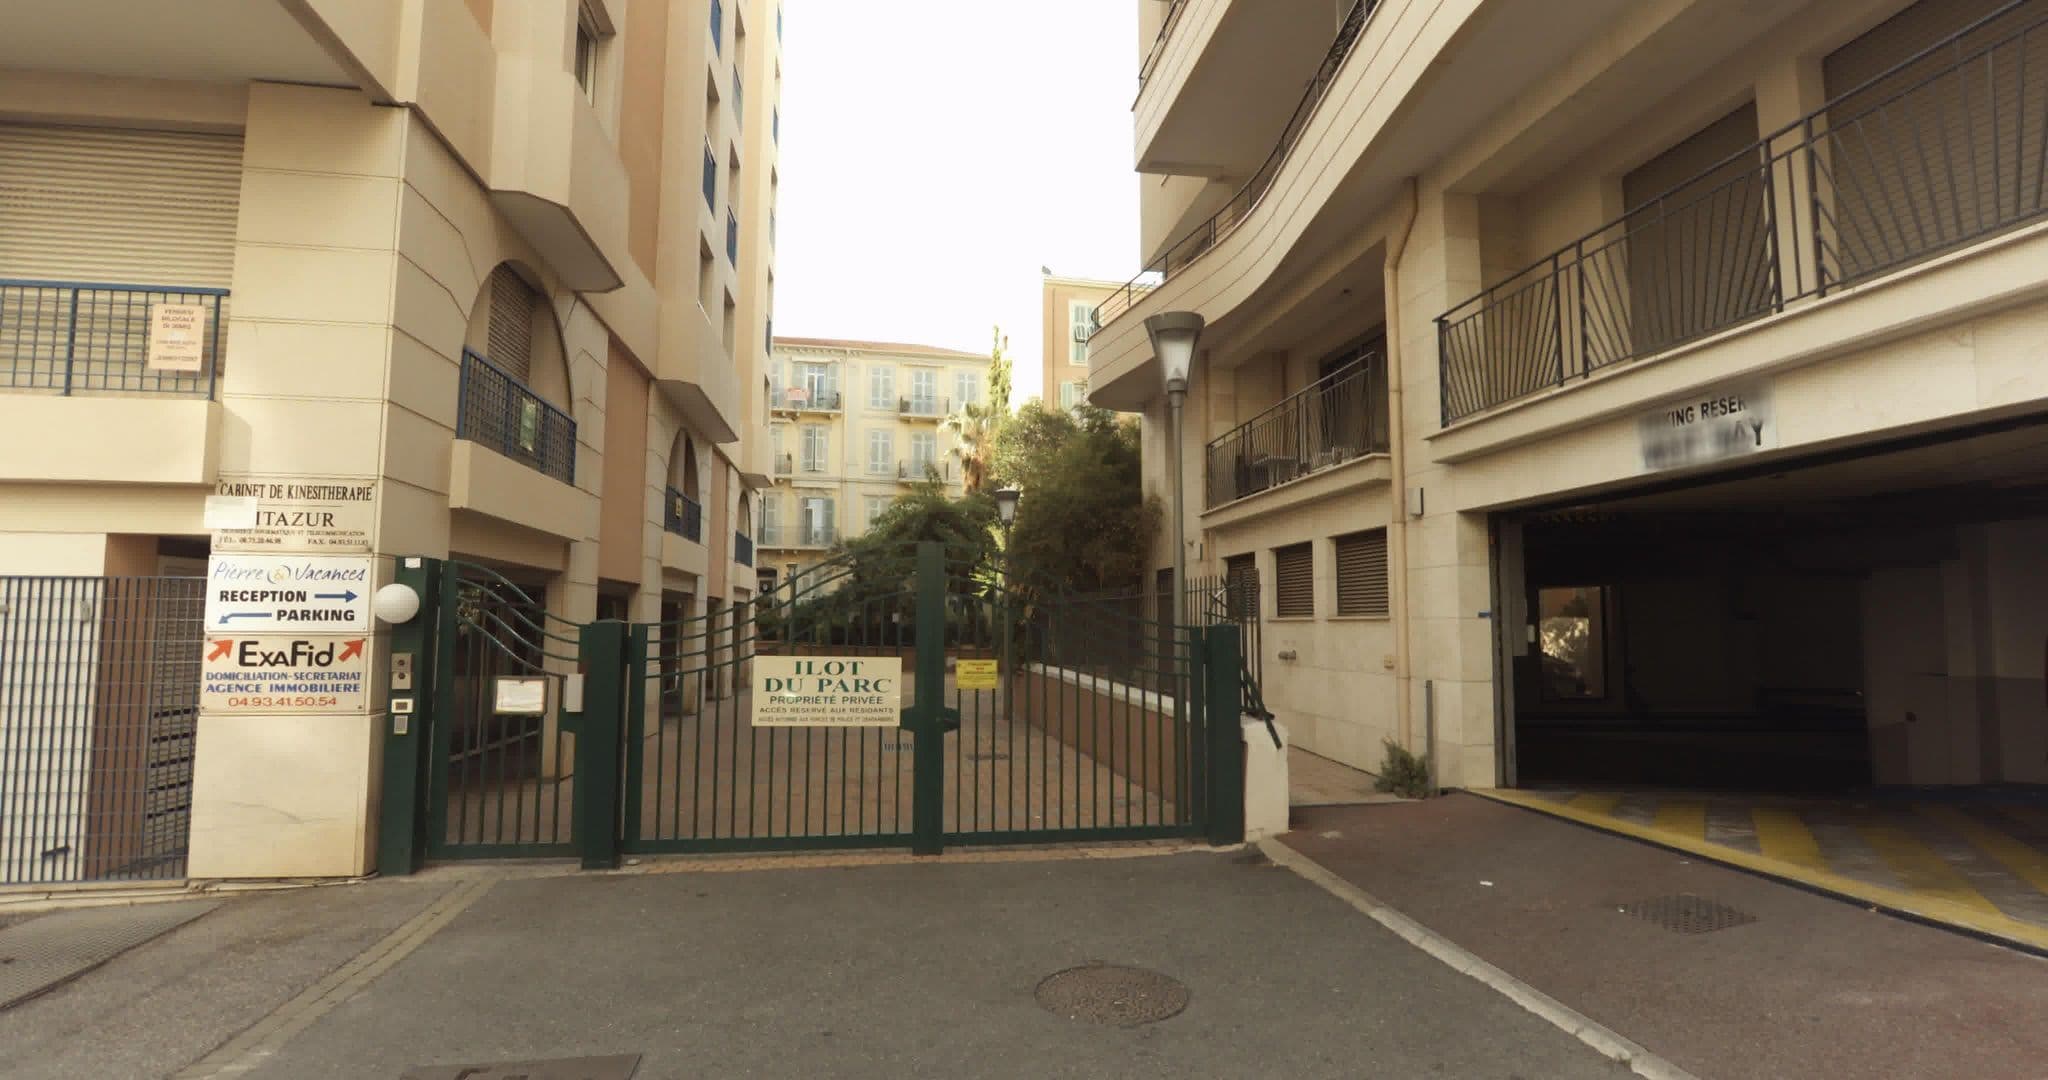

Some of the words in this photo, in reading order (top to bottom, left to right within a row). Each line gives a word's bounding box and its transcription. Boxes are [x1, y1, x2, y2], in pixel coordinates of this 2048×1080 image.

[220, 483, 266, 498] CABINET
[269, 485, 283, 499] DE
[288, 485, 373, 501] KINESITHERAPIE
[255, 511, 336, 527] ITAZUR
[213, 561, 264, 581] Pierre
[295, 563, 367, 582] Vacances
[219, 590, 307, 602] RECEPTION
[276, 609, 355, 622] PARKING
[795, 660, 865, 675] ILOT
[205, 683, 263, 693] AGENCE
[269, 683, 361, 693] IMMOBILIERE
[764, 677, 804, 693] DU
[818, 678, 892, 693] PARC
[228, 696, 337, 707] 04.93.41.50.54
